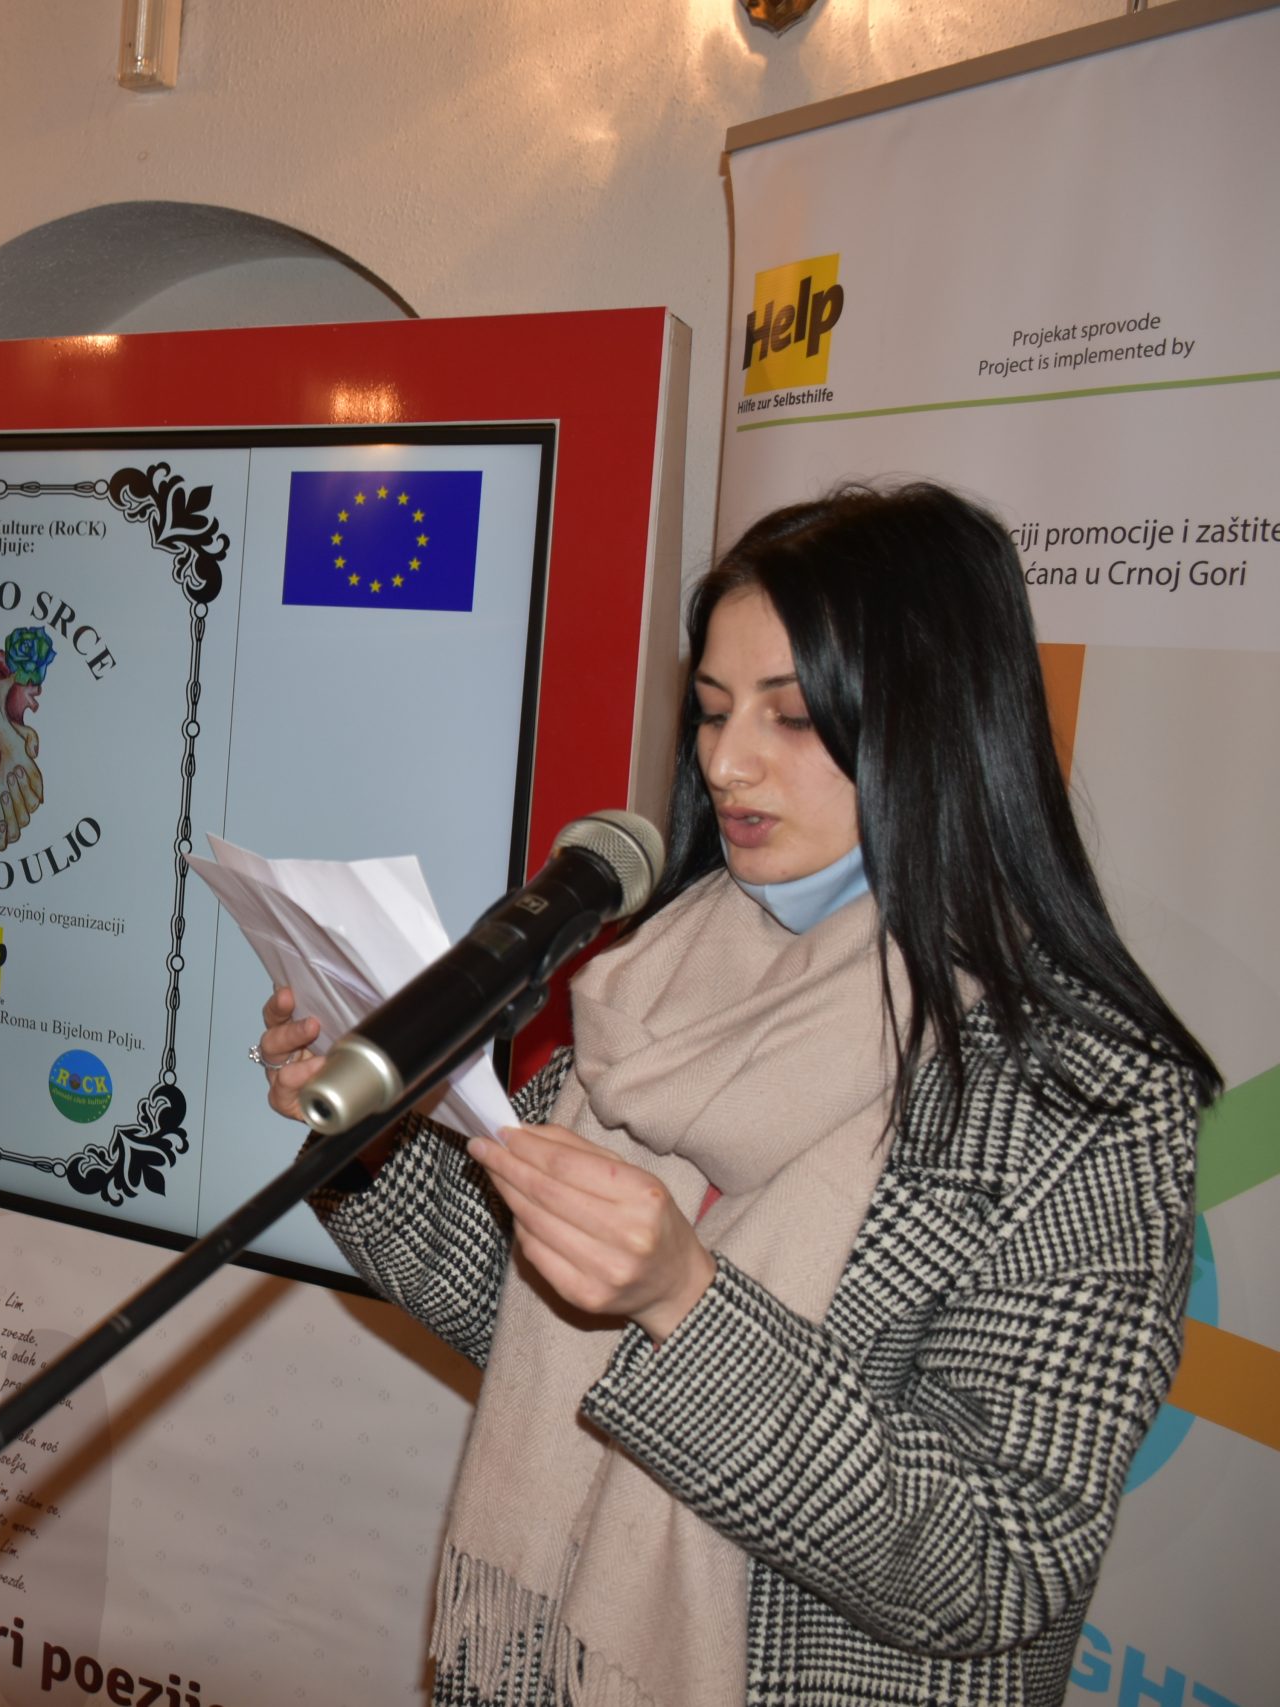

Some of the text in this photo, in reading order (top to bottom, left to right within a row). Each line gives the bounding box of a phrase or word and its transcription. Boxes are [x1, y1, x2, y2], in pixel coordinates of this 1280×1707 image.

[742, 276, 844, 371] Help
[1013, 312, 1161, 348] Projekat sprovode
[978, 338, 1195, 377] Project is implemented by
[737, 388, 833, 414] Hilfe zur Selbsthilfe
[49, 520, 106, 539] (RoCK)
[1009, 516, 1280, 552] ciji promocije i zaštite
[1024, 560, 1247, 592] ćana u Crnoj Gori
[30, 591, 116, 680] SRCE
[18, 817, 101, 884] ULJO
[50, 914, 125, 936] organizaciji
[0, 1010, 36, 1030] Roma
[40, 1022, 48, 1032] u
[52, 1020, 103, 1042] Bijelom
[108, 1030, 145, 1051] Polju.
[6, 1292, 25, 1312] Lim.
[1, 1328, 38, 1346] zvezde.
[12, 1351, 36, 1367] odoh
[40, 1638, 223, 1707] poezi
